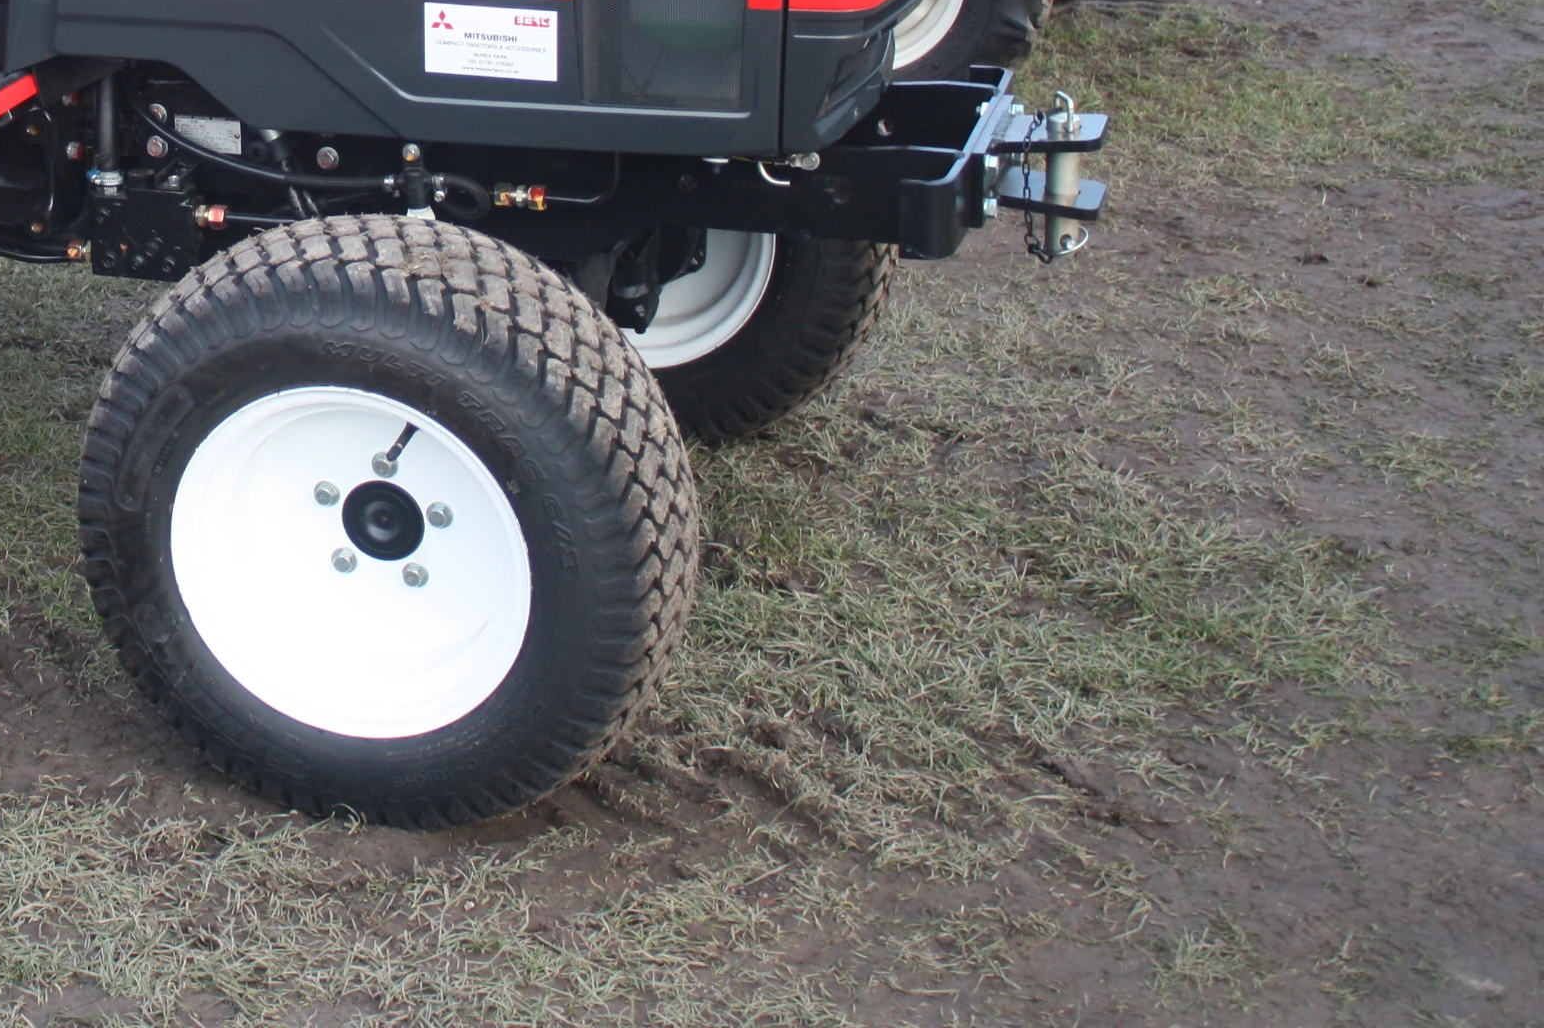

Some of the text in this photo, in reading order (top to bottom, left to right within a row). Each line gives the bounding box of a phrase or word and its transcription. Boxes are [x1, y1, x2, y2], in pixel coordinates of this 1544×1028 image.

[464, 32, 518, 43] MITSUBISHI
[435, 39, 465, 48] COMPACT
[466, 41, 498, 50] TRACTORS
[505, 45, 548, 54] ACCESSORIES
[320, 340, 447, 387] MULTI
[459, 392, 548, 483] TRAC
